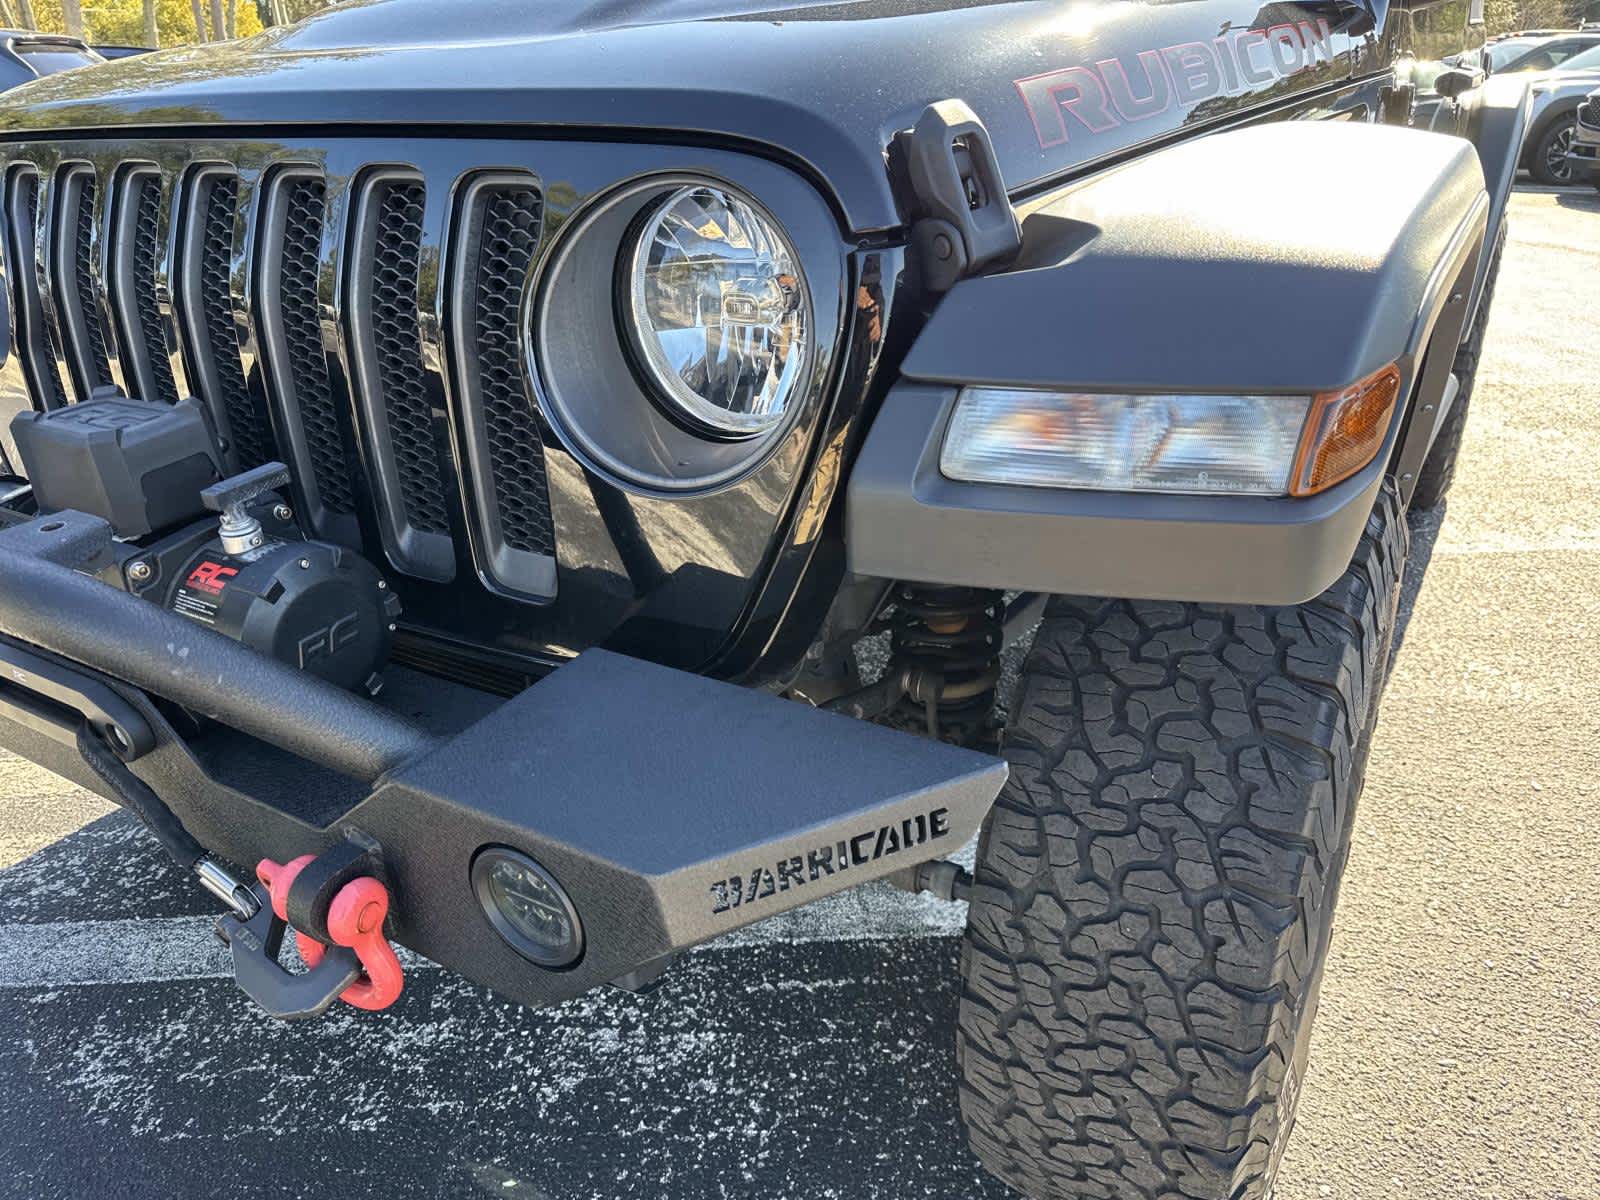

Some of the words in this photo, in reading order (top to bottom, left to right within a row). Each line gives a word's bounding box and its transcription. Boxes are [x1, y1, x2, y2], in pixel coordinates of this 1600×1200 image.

[1013, 18, 1335, 149] RUBICON
[188, 560, 239, 590] RC
[710, 807, 950, 914] BARRICADE
